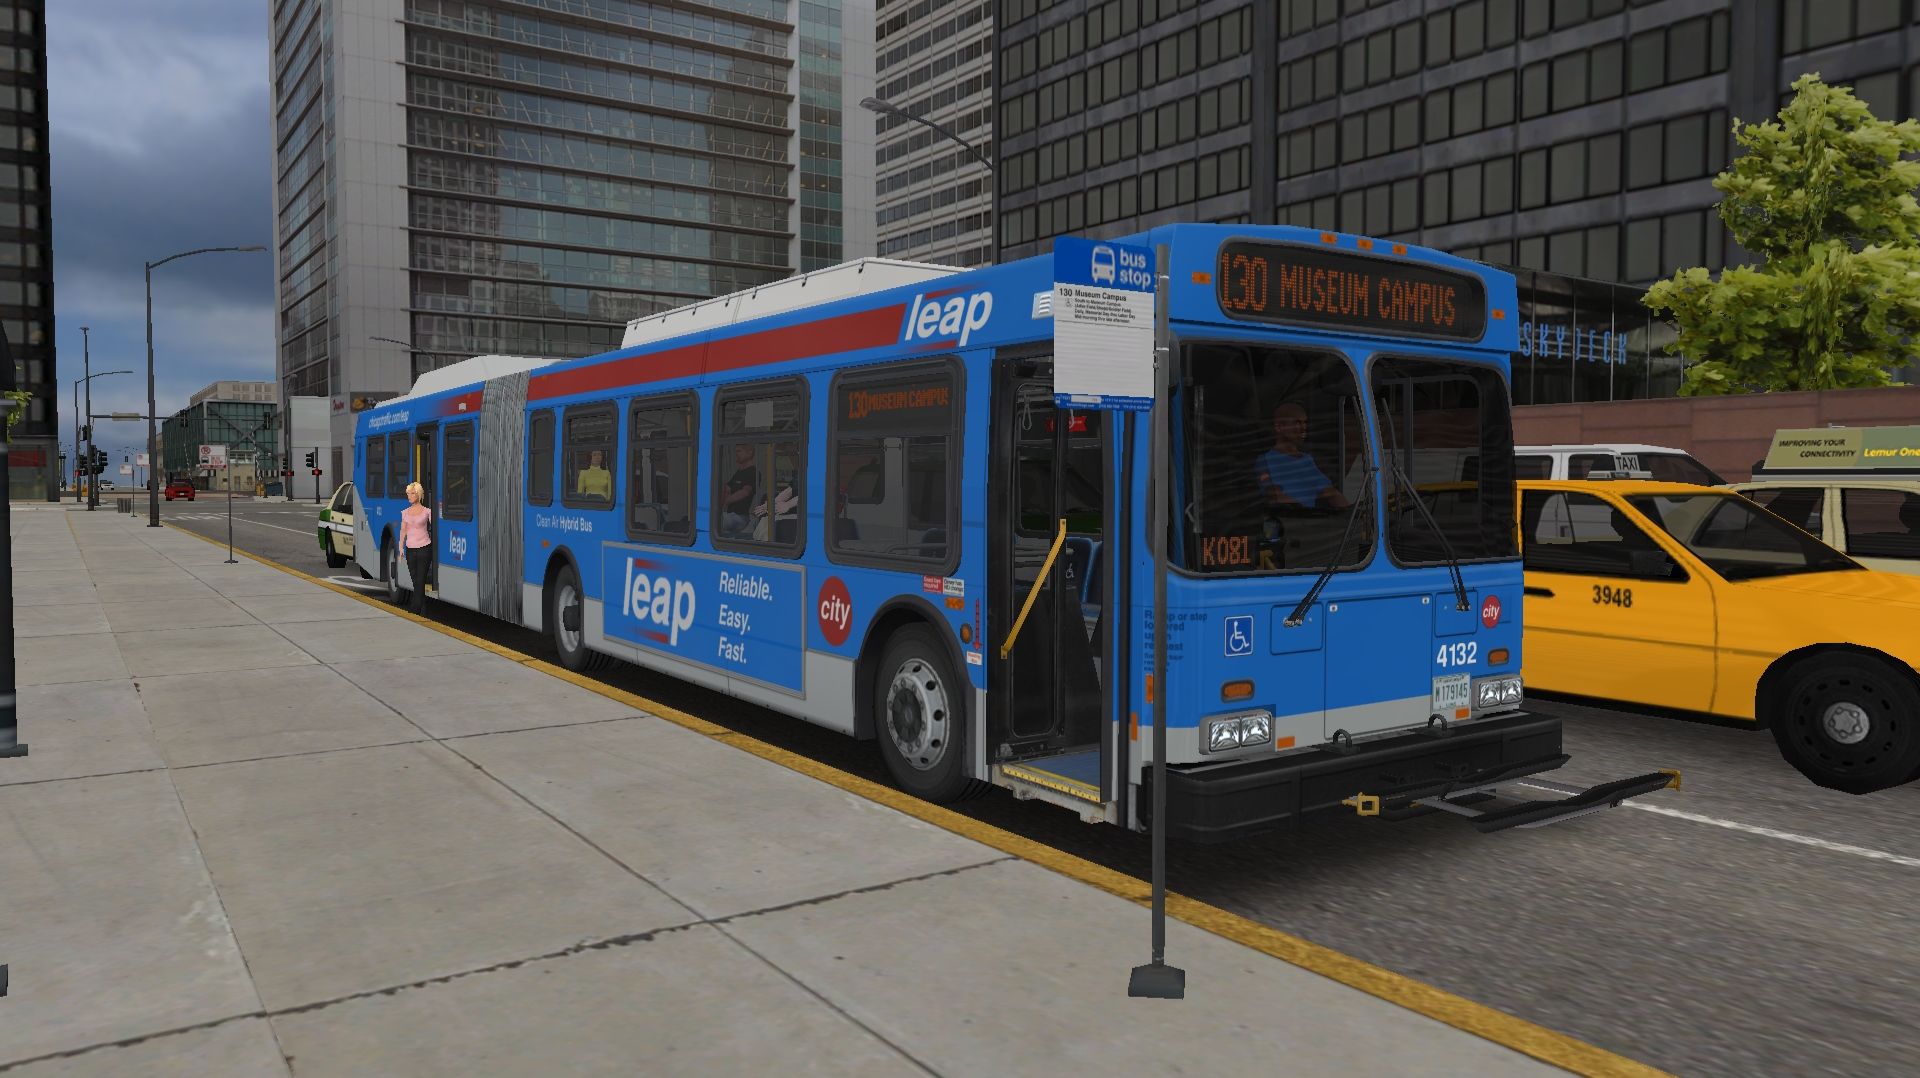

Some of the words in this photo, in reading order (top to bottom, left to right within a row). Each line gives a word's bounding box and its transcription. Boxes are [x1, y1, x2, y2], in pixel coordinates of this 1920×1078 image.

[1120, 248, 1146, 268] bus
[1120, 269, 1151, 290] stop
[1222, 252, 1267, 312] 130
[1280, 264, 1369, 317] MUSEUM
[1378, 277, 1456, 327] CAMPUS
[1059, 288, 1073, 297] 130
[1075, 289, 1101, 299] Museum
[1102, 292, 1127, 302] Campus
[905, 291, 993, 347] leap
[1778, 439, 1822, 447] IMPROVING
[1824, 438, 1846, 446] YOUR
[1863, 448, 1897, 457] Lemur
[1900, 447, 1920, 457] One
[1615, 456, 1638, 471] TAXI
[1800, 450, 1857, 458] CONNECTIVITY
[536, 513, 551, 528] Clean
[560, 515, 579, 533] Hybrid
[580, 517, 592, 532] Bus
[449, 530, 467, 560] leap
[719, 571, 773, 601] Reliable.
[1592, 584, 1633, 608] 3948
[623, 557, 696, 646] leap
[718, 604, 751, 635] Easy.
[820, 595, 851, 630] city
[1144, 610, 1176, 622] Rp
[1482, 605, 1500, 620] city
[1144, 620, 1185, 631] lored
[718, 636, 747, 664] Fast.
[1436, 641, 1478, 668] 4132
[1442, 682, 1468, 702] 179145
